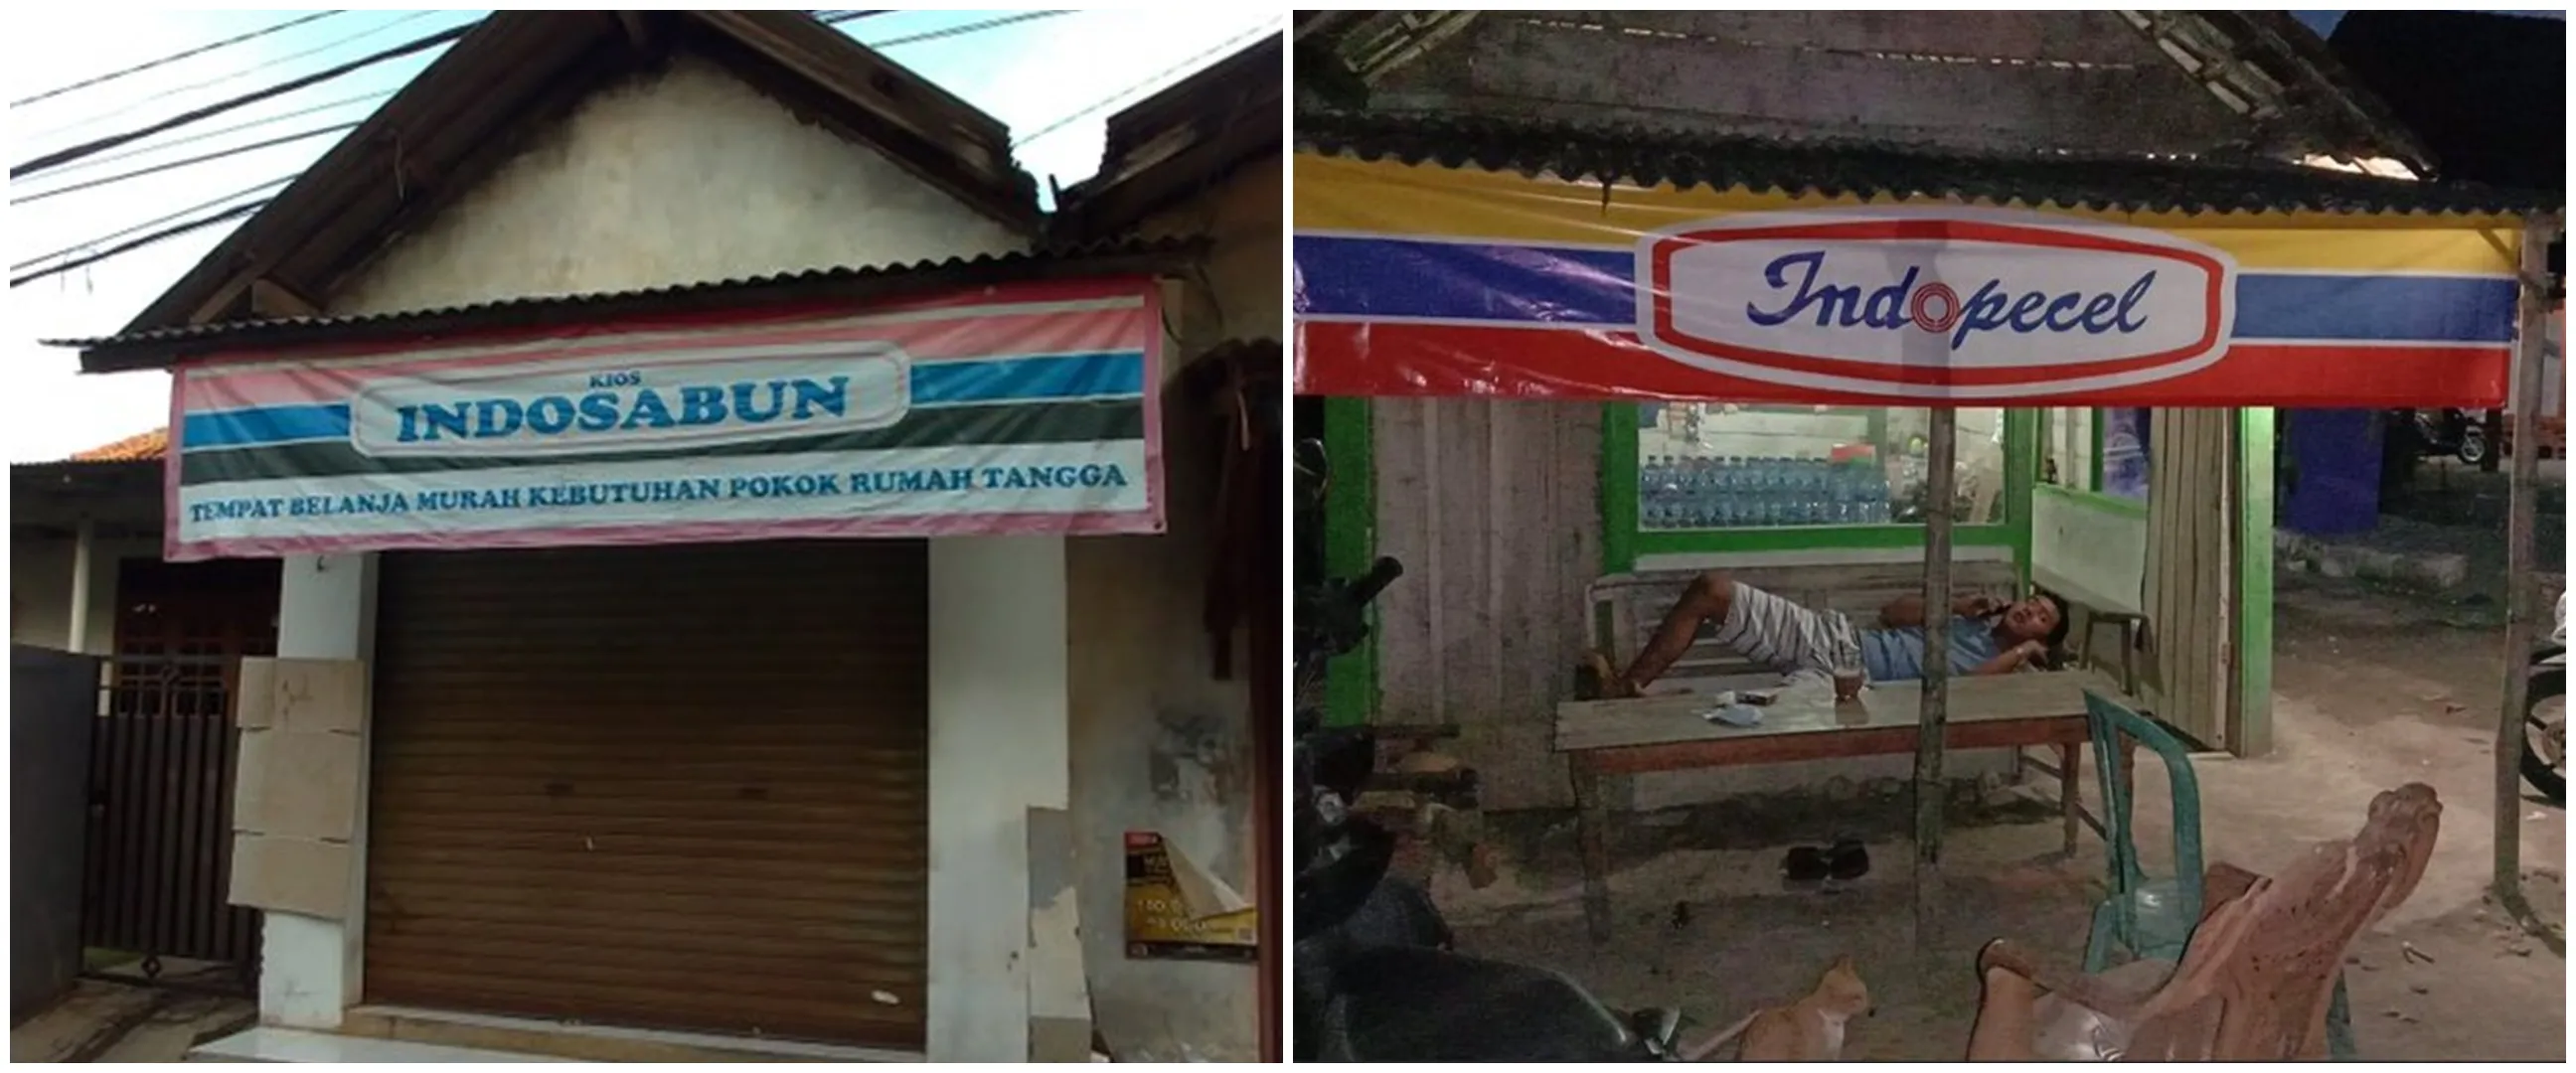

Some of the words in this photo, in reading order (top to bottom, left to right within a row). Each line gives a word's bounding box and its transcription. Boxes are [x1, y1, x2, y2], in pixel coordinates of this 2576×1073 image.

[1745, 249, 2158, 351] Indopecel
[396, 375, 850, 443] INDOSABUN
[589, 370, 642, 388] KIOS
[189, 498, 284, 523] TEMPAT
[288, 492, 409, 516] BELANJA
[415, 488, 522, 512] MURAH
[527, 478, 721, 508] KEBUTUHAN
[728, 473, 842, 497] POKOK
[850, 466, 973, 494] RUMAH
[980, 463, 1128, 490] TANGGA
